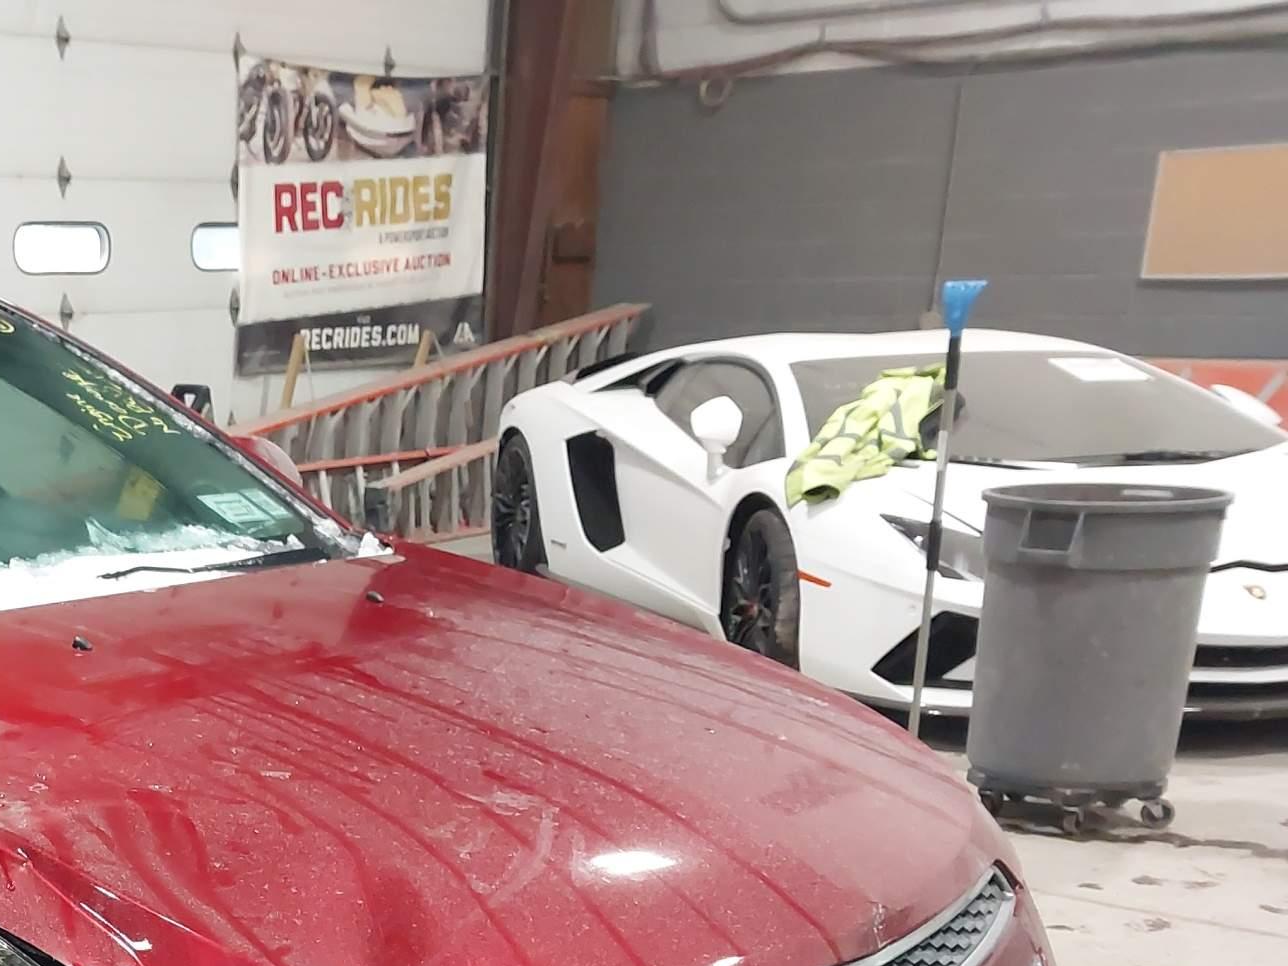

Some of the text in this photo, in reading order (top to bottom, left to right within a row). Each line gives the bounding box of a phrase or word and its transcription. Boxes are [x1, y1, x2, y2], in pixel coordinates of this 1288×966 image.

[273, 173, 453, 233] REC RIDES
[272, 252, 453, 286] ONLINE-EXCLUSIVE AUCTION
[299, 323, 420, 352] RECRIDES.COM
